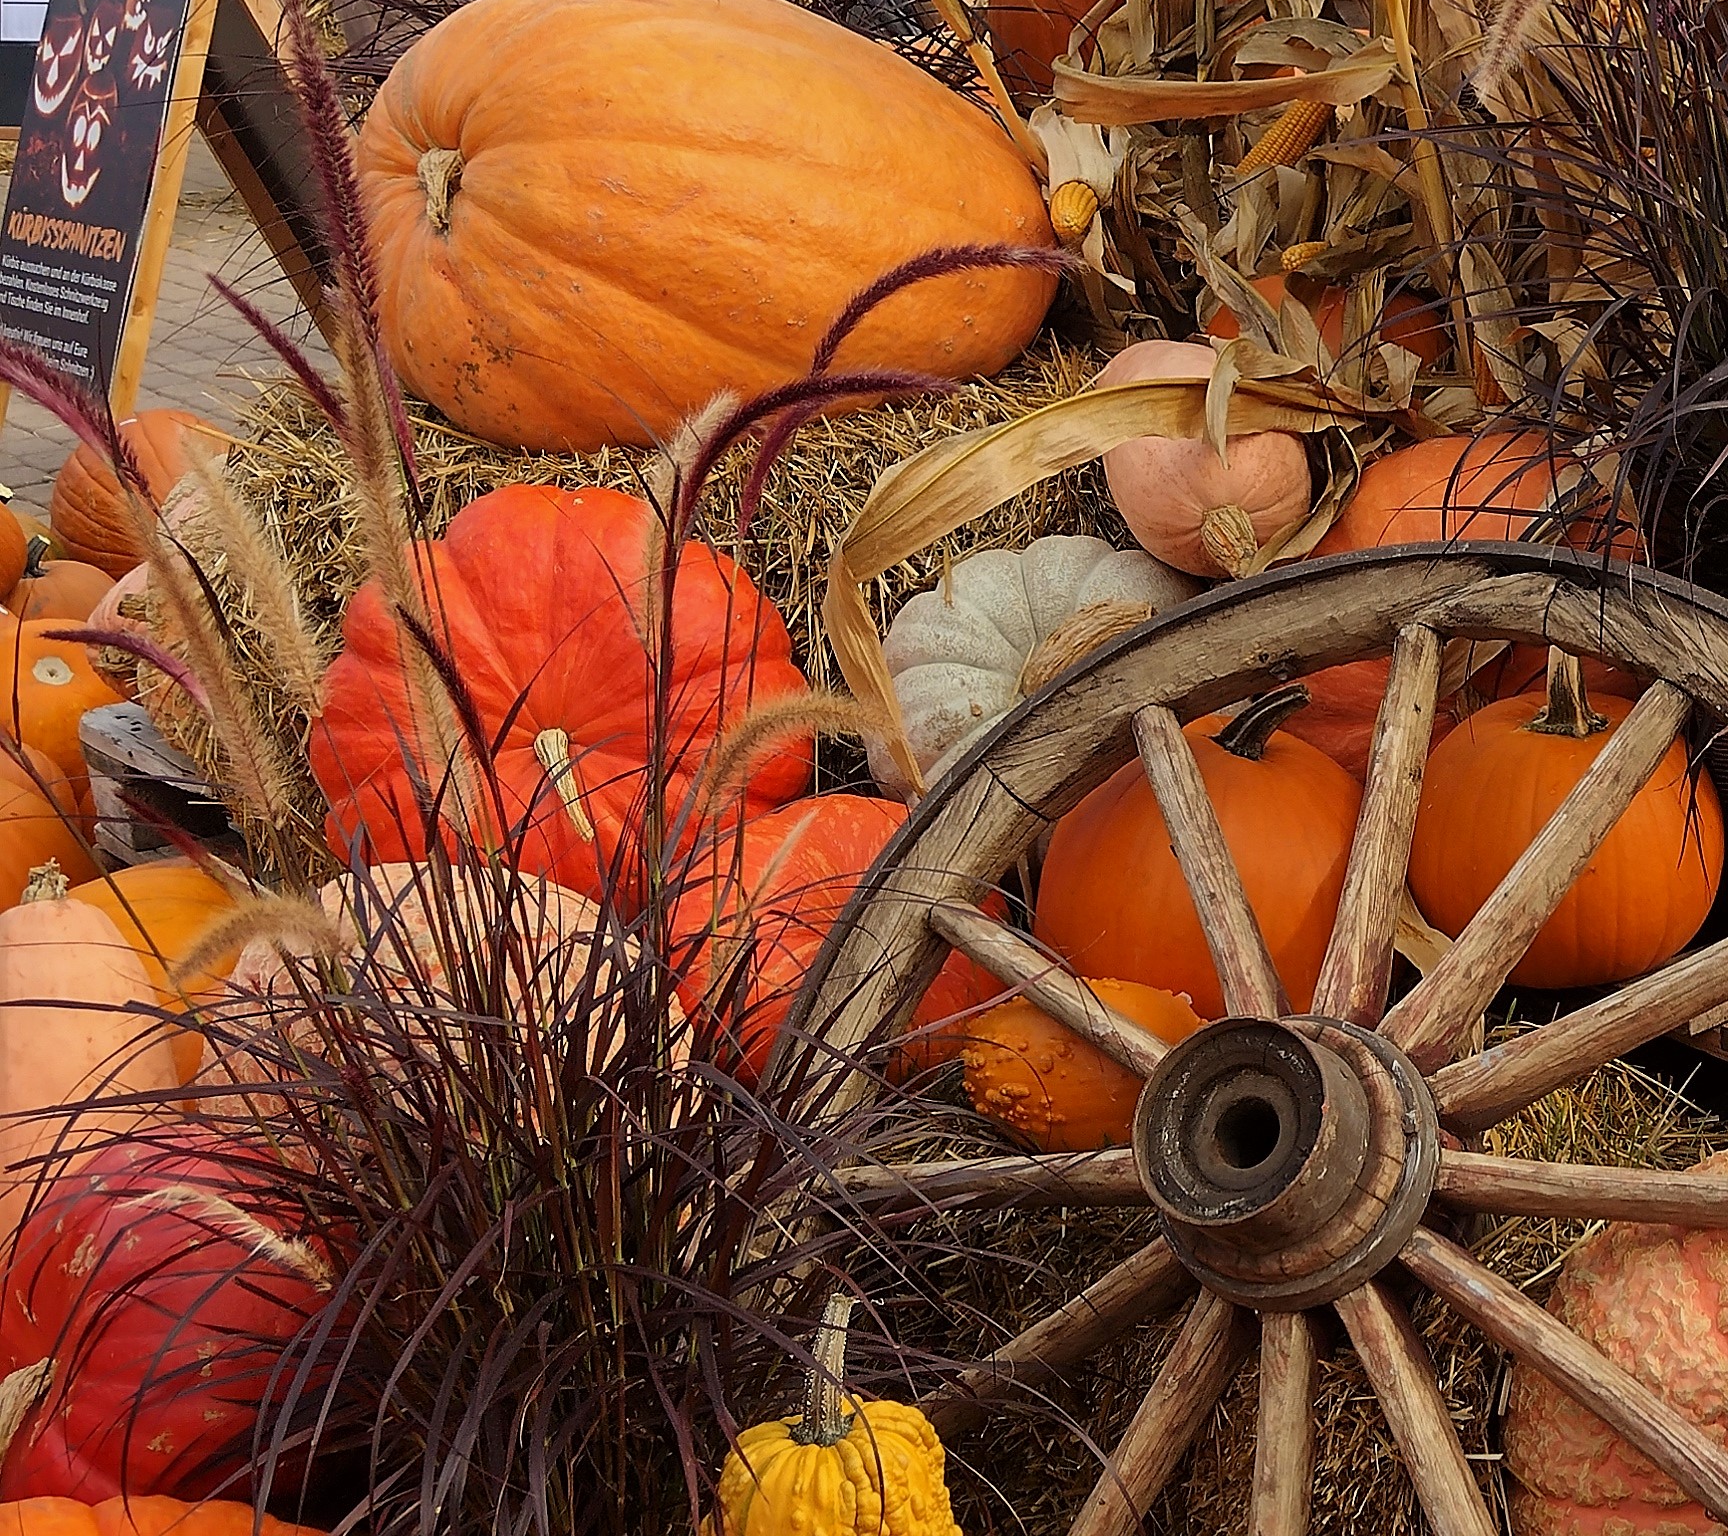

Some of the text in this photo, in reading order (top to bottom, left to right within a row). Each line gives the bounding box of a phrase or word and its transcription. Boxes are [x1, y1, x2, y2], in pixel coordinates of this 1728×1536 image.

[8, 206, 127, 263] KÜRBISSCHNITZEN
[2, 254, 20, 269] Kürbis
[20, 261, 50, 276] aussuchen
[50, 266, 63, 279] und
[62, 270, 70, 281] an
[71, 270, 81, 283] der
[25, 278, 59, 298] Kostenloses
[7, 292, 25, 308] Tische
[26, 296, 43, 312] finden
[44, 301, 53, 316] Sie
[54, 303, 62, 316] im
[52, 340, 63, 351] uns
[63, 341, 75, 354] auf
[74, 342, 88, 358] Eure
